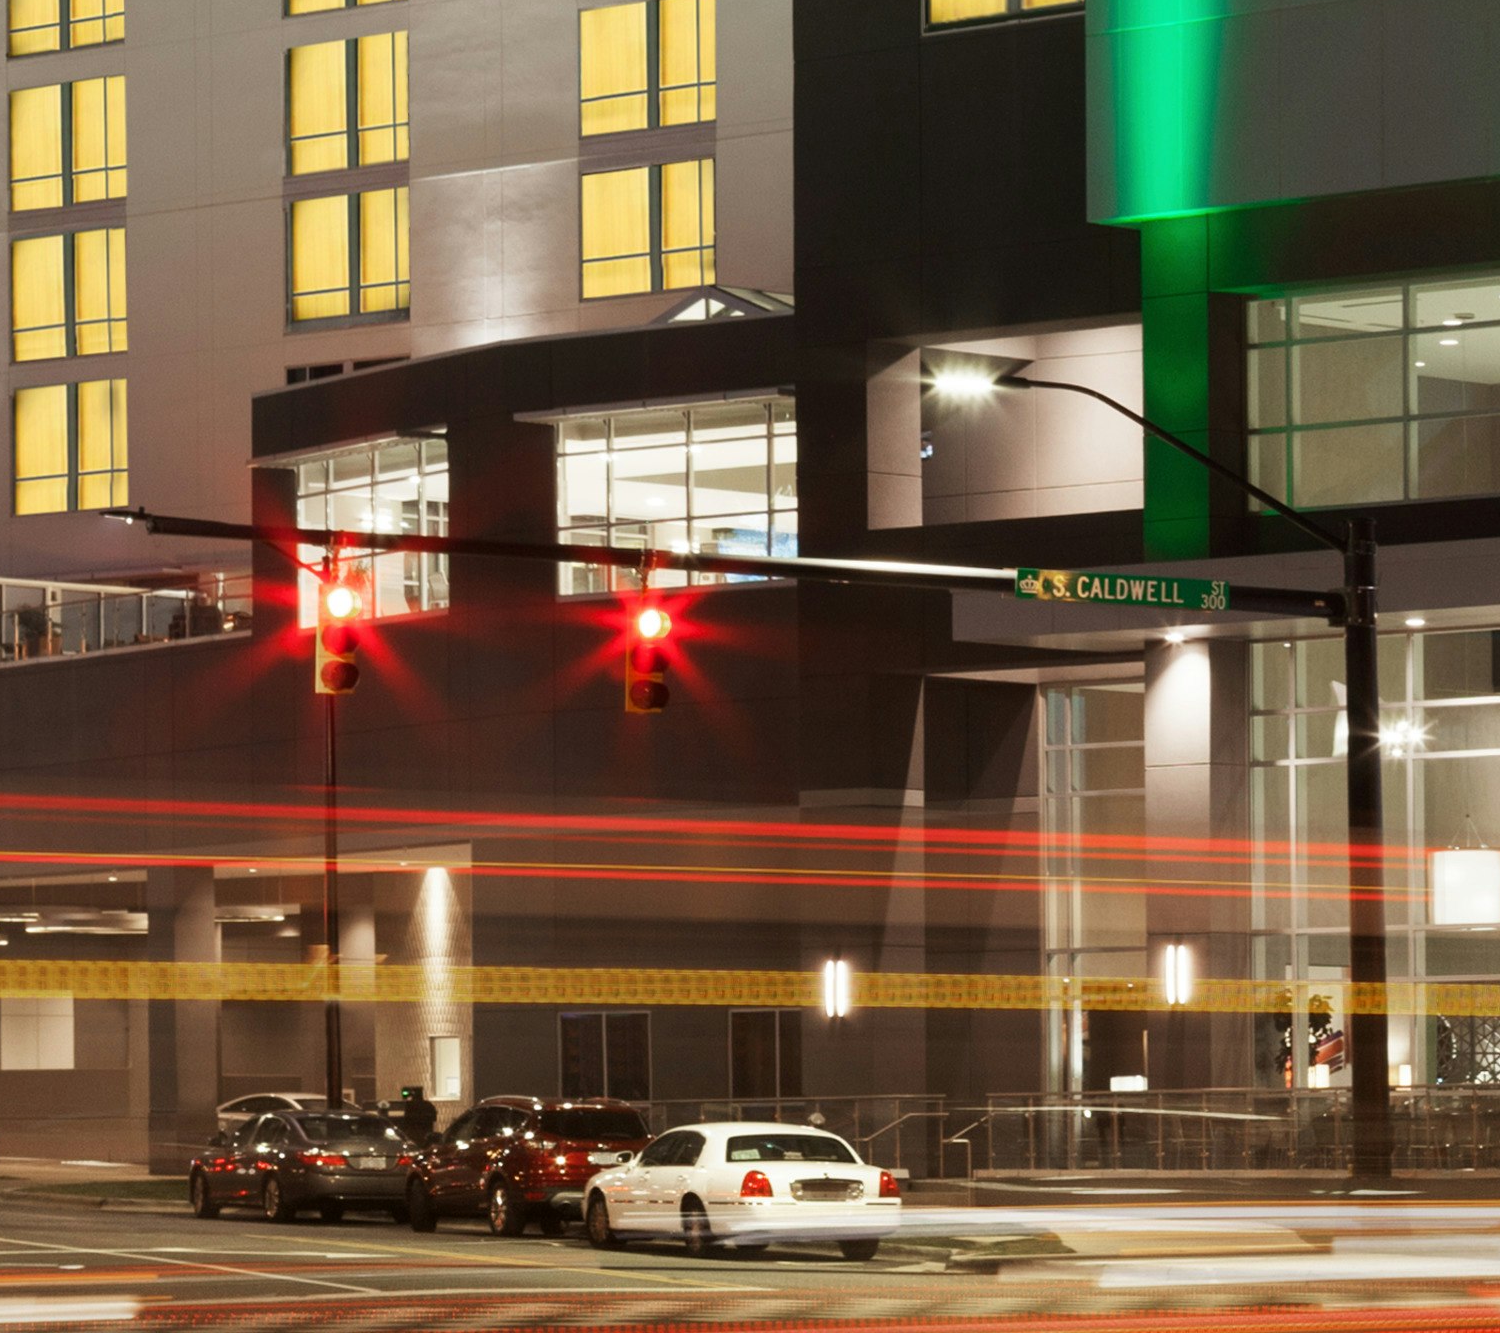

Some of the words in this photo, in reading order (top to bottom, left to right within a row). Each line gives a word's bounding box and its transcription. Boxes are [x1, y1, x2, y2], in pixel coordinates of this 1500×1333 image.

[1052, 574, 1071, 598] S.
[1076, 575, 1185, 604] CALDWELL
[1211, 580, 1226, 596] ST
[1201, 594, 1227, 611] 300
